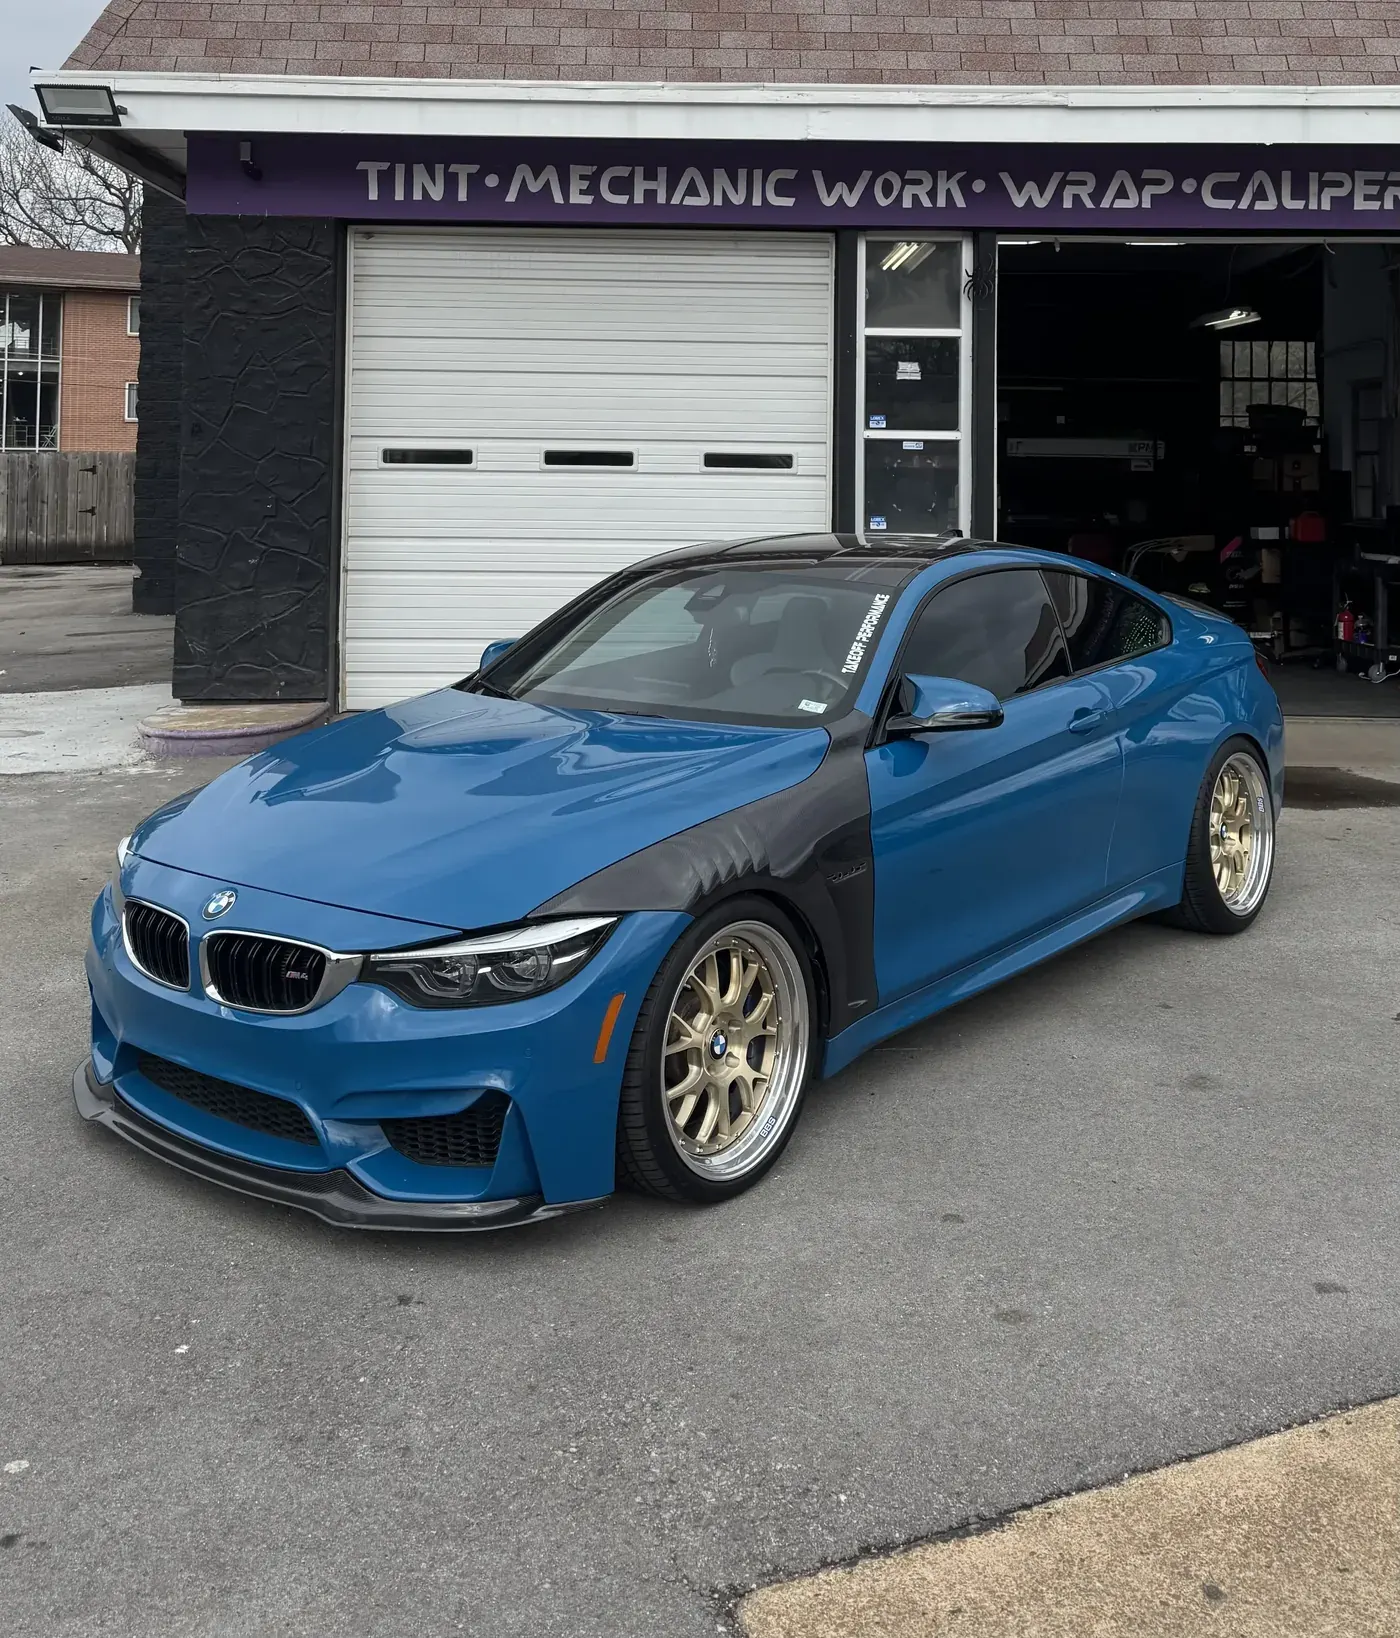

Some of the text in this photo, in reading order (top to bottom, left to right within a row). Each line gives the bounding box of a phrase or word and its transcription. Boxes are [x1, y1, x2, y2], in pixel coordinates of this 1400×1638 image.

[356, 161, 481, 202] TINT
[504, 163, 799, 207] MECHANIC
[812, 169, 968, 209] WORK
[999, 169, 1175, 209] WRAP
[841, 593, 891, 674] TAKEOFF PERFORMANCE
[759, 1116, 777, 1138] BBS
